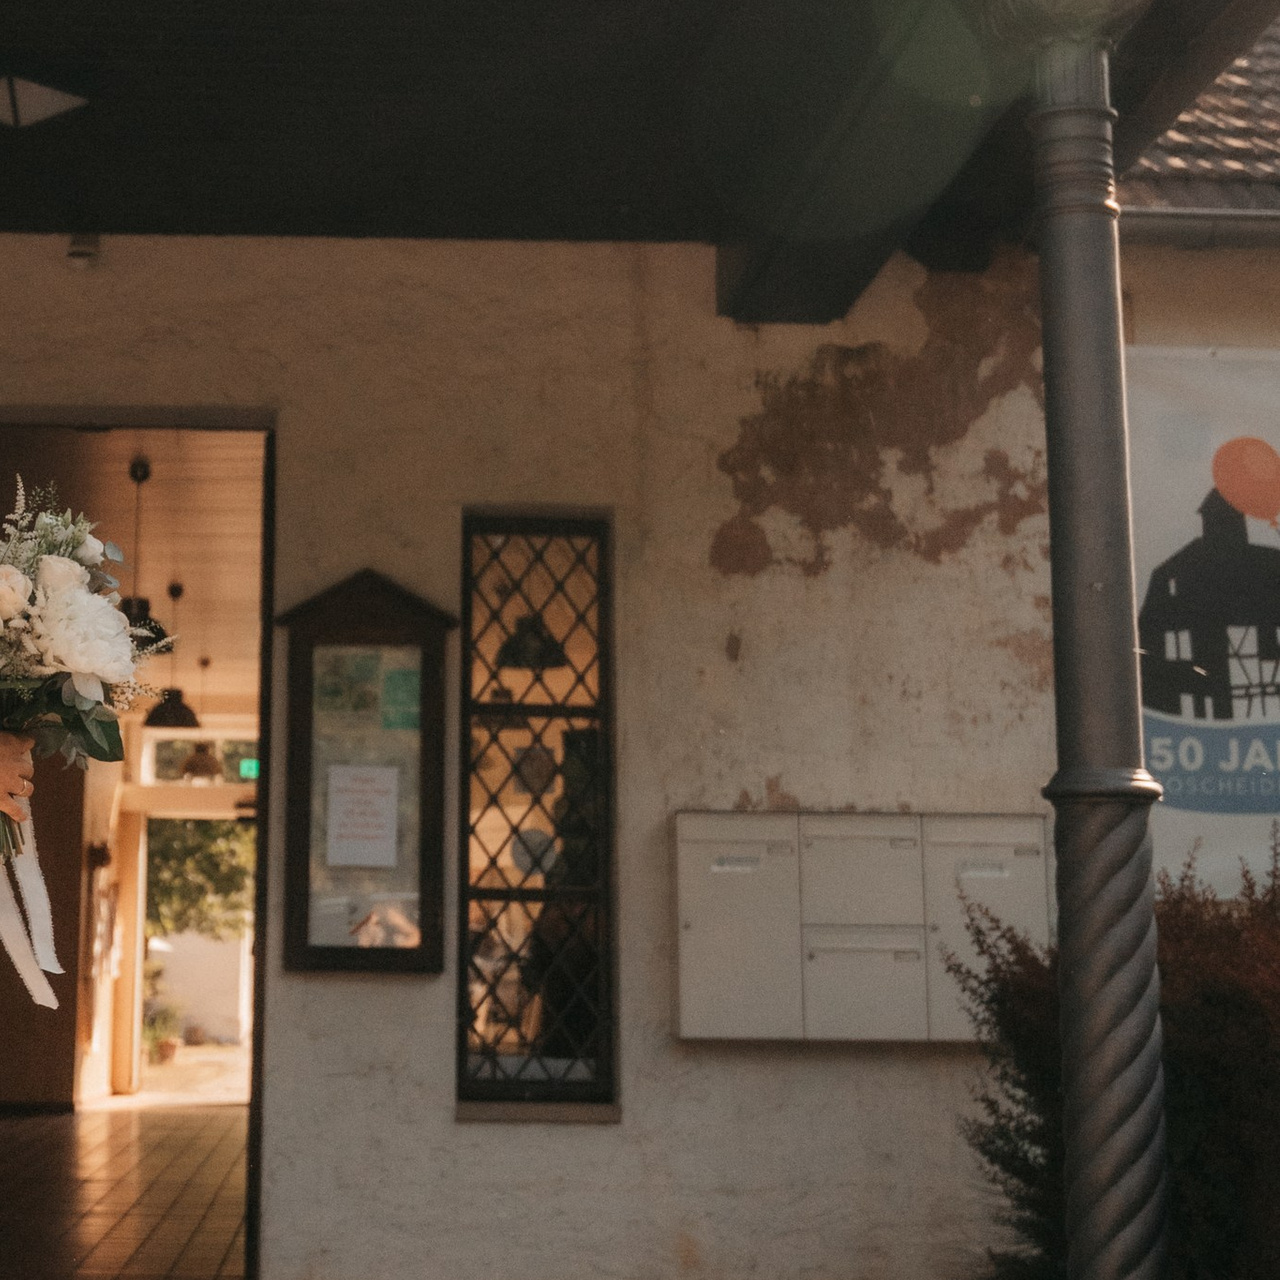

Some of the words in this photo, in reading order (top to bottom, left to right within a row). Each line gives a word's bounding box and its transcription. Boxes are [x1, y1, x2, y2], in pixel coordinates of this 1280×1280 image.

[1150, 737, 1204, 771] 50
[1218, 738, 1280, 772] JA
[1163, 775, 1280, 796] OSCHEID
